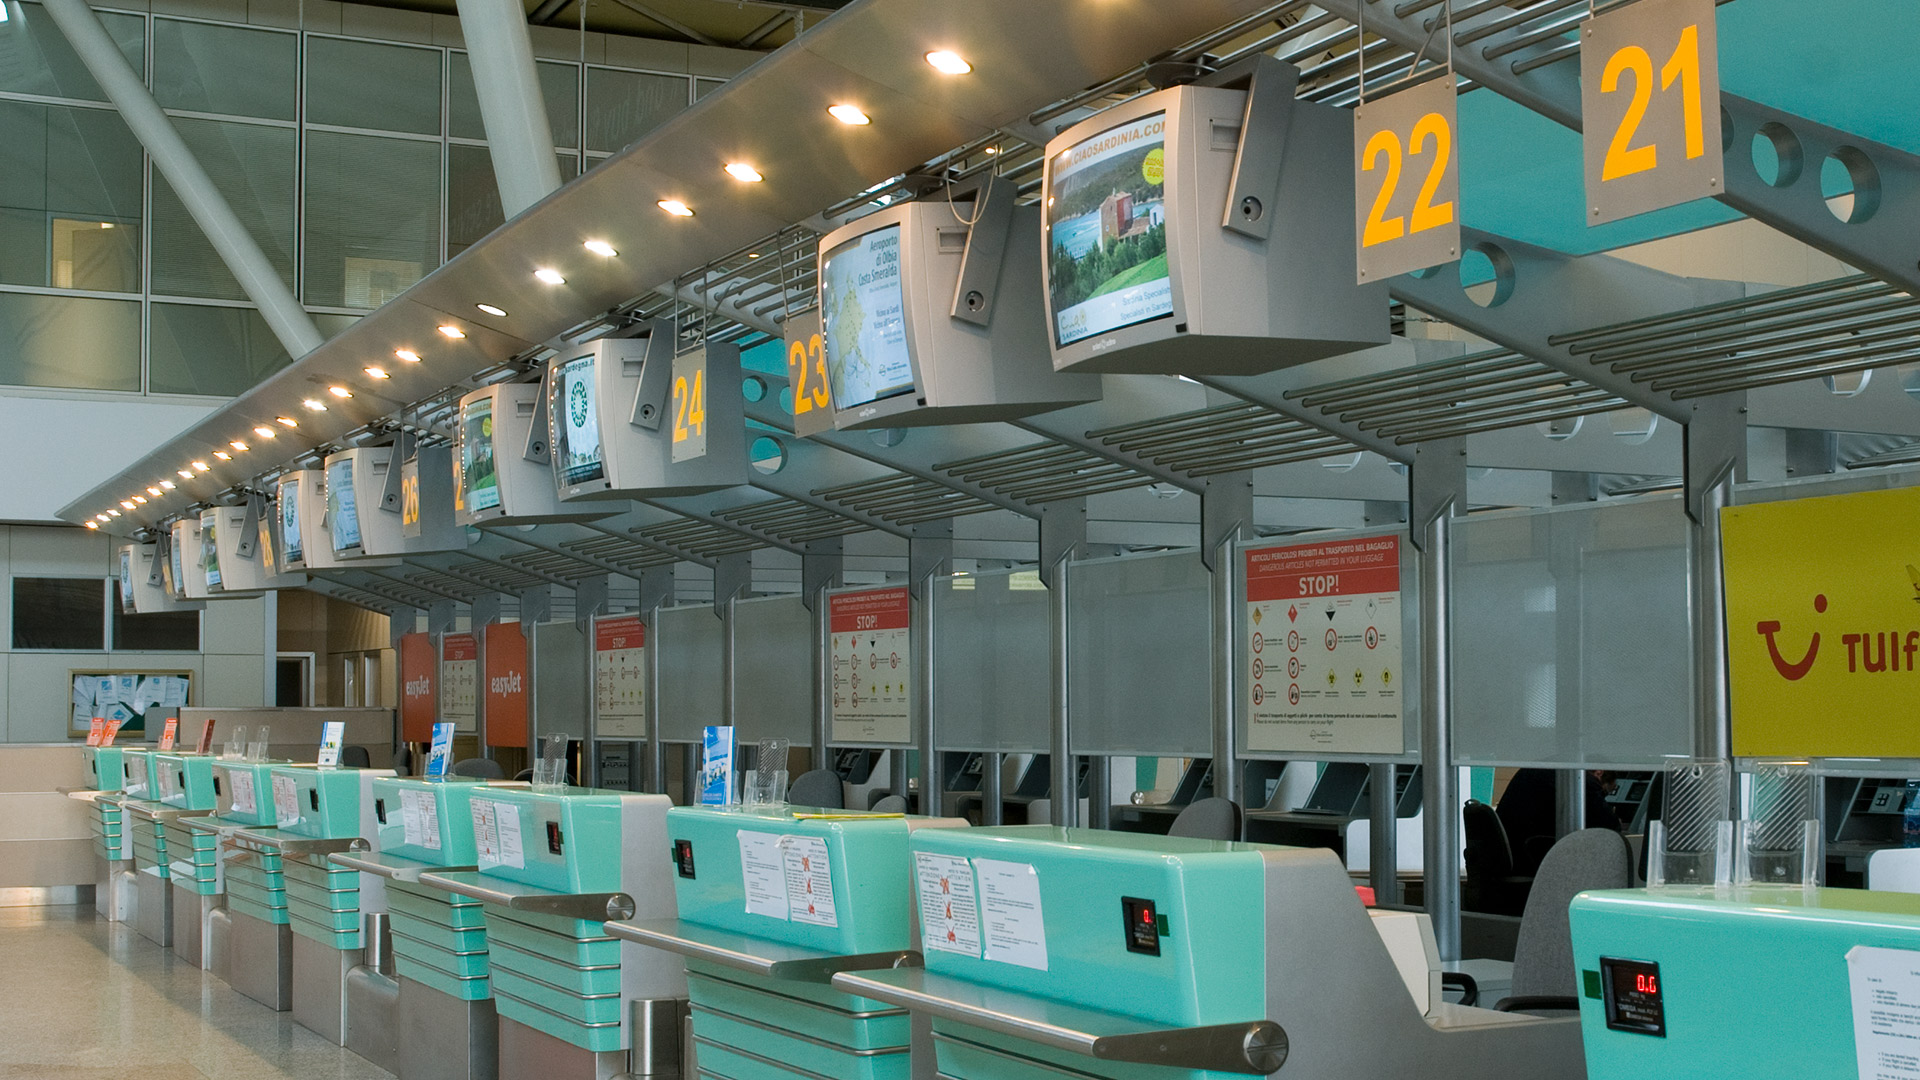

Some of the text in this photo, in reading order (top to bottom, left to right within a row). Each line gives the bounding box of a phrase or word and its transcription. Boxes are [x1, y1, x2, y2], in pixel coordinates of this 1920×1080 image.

[1601, 24, 1704, 182] 21
[1362, 112, 1453, 248] 22
[789, 333, 829, 415] 23
[672, 369, 704, 443] 24
[402, 475, 419, 525] 26
[453, 461, 464, 511] 2
[1299, 575, 1339, 595] STOP!
[856, 615, 878, 629] STOP!
[406, 674, 430, 699] easyJet
[491, 670, 521, 698] easyJet
